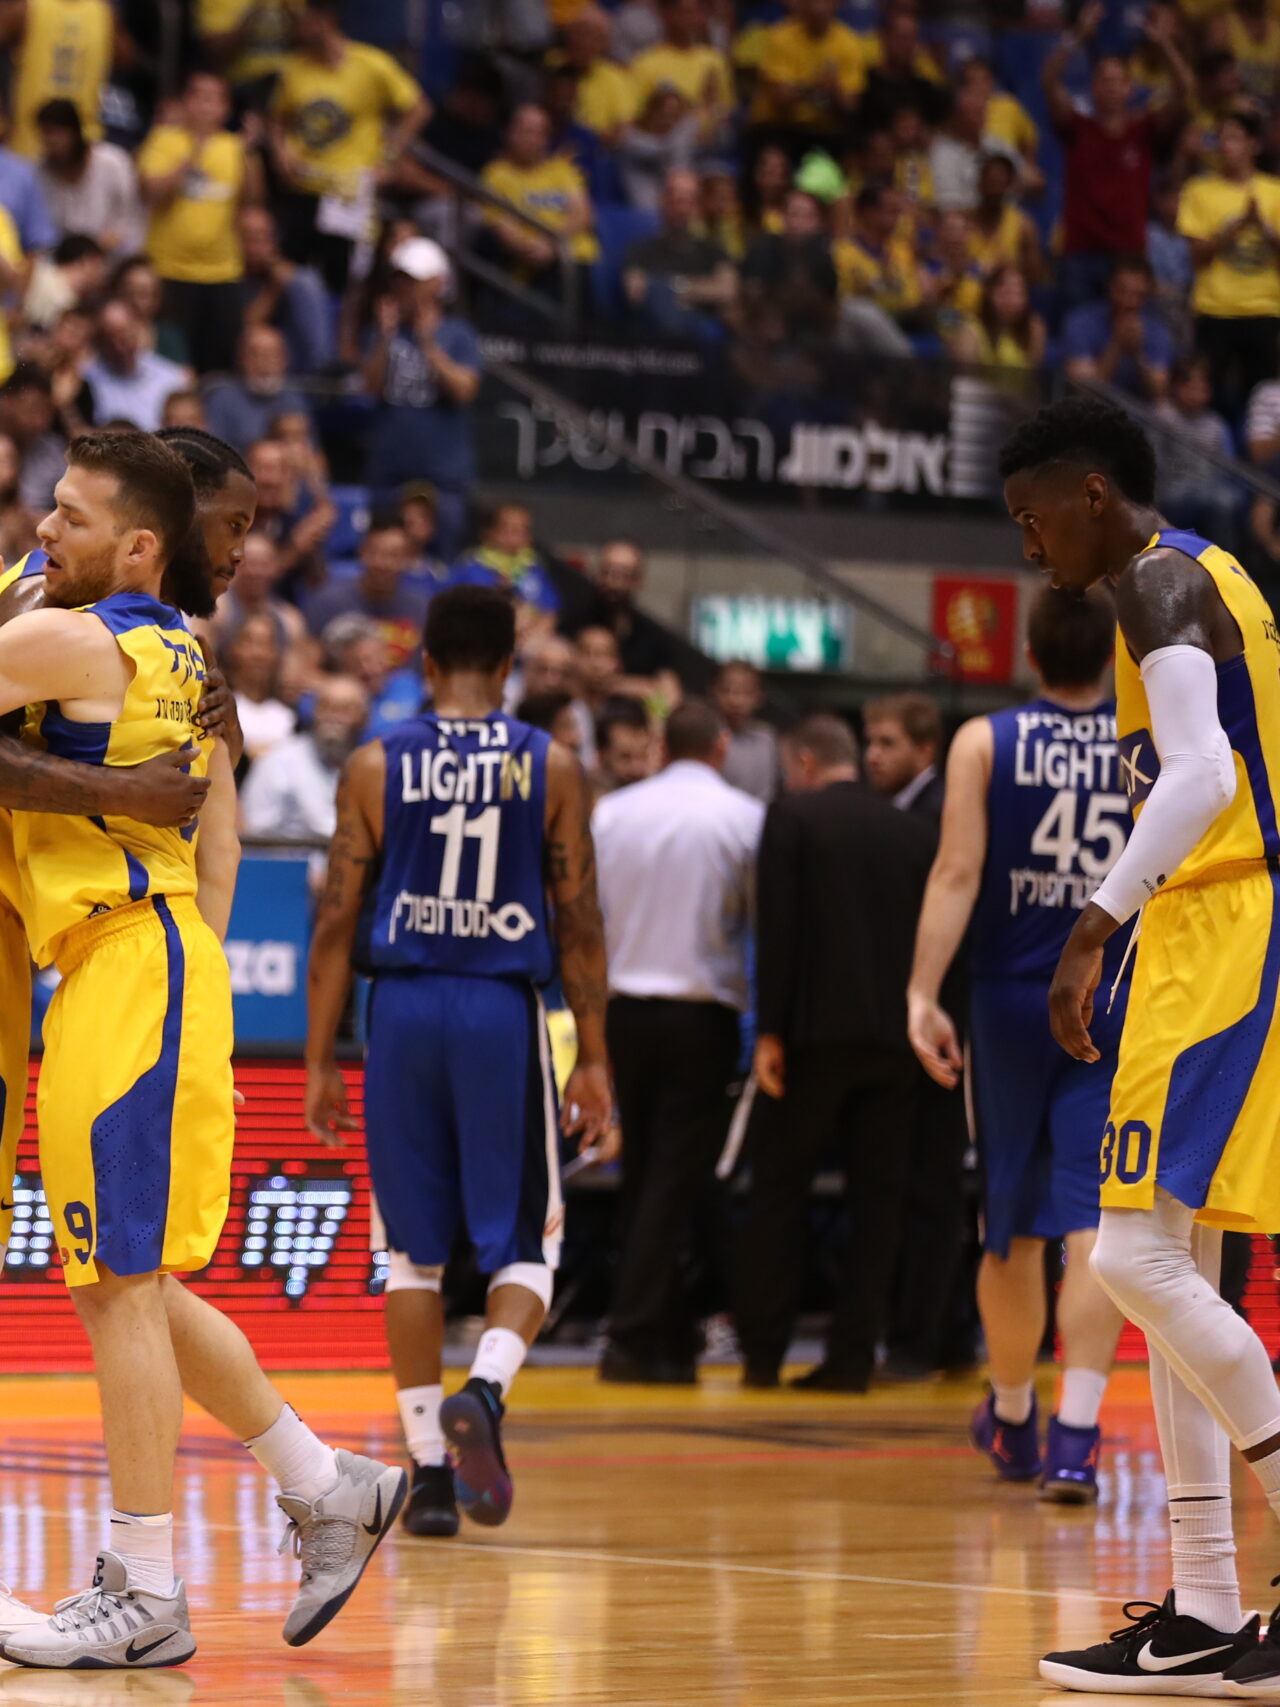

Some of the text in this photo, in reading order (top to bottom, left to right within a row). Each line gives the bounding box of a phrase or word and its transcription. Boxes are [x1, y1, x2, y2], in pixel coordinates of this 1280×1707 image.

[430, 803, 501, 902] 11
[1031, 789, 1130, 880] 45
[1100, 1119, 1152, 1185] 30
[63, 1201, 93, 1265] 9
